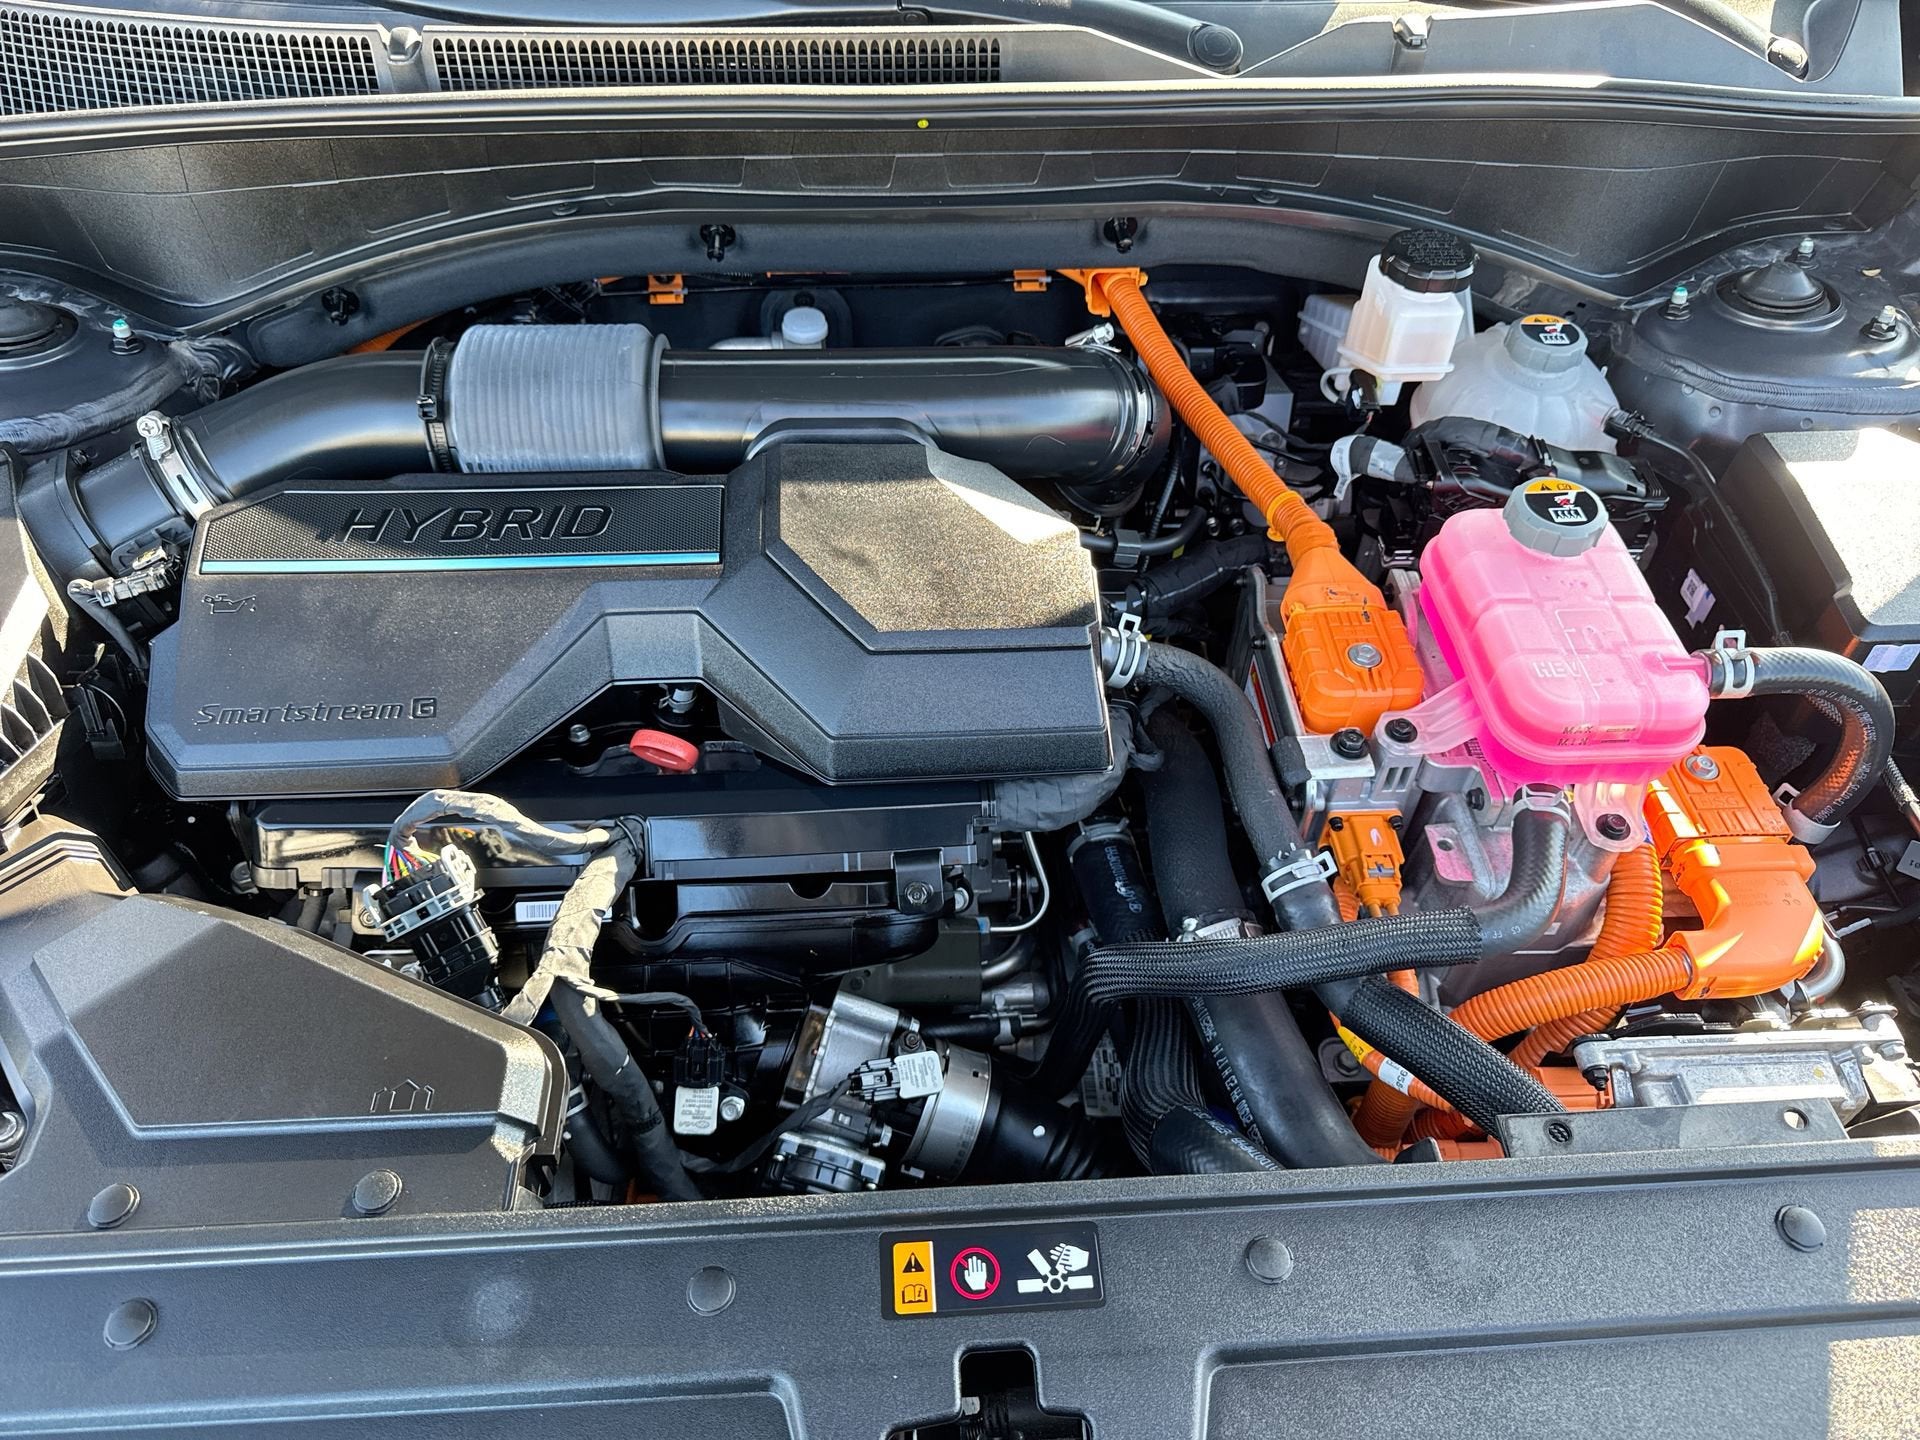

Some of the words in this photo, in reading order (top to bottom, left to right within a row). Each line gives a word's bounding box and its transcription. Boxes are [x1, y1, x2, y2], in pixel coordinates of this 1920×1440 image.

[334, 503, 615, 543] HYBRID
[1532, 661, 1582, 678] HEV
[195, 700, 404, 727] Smartstream
